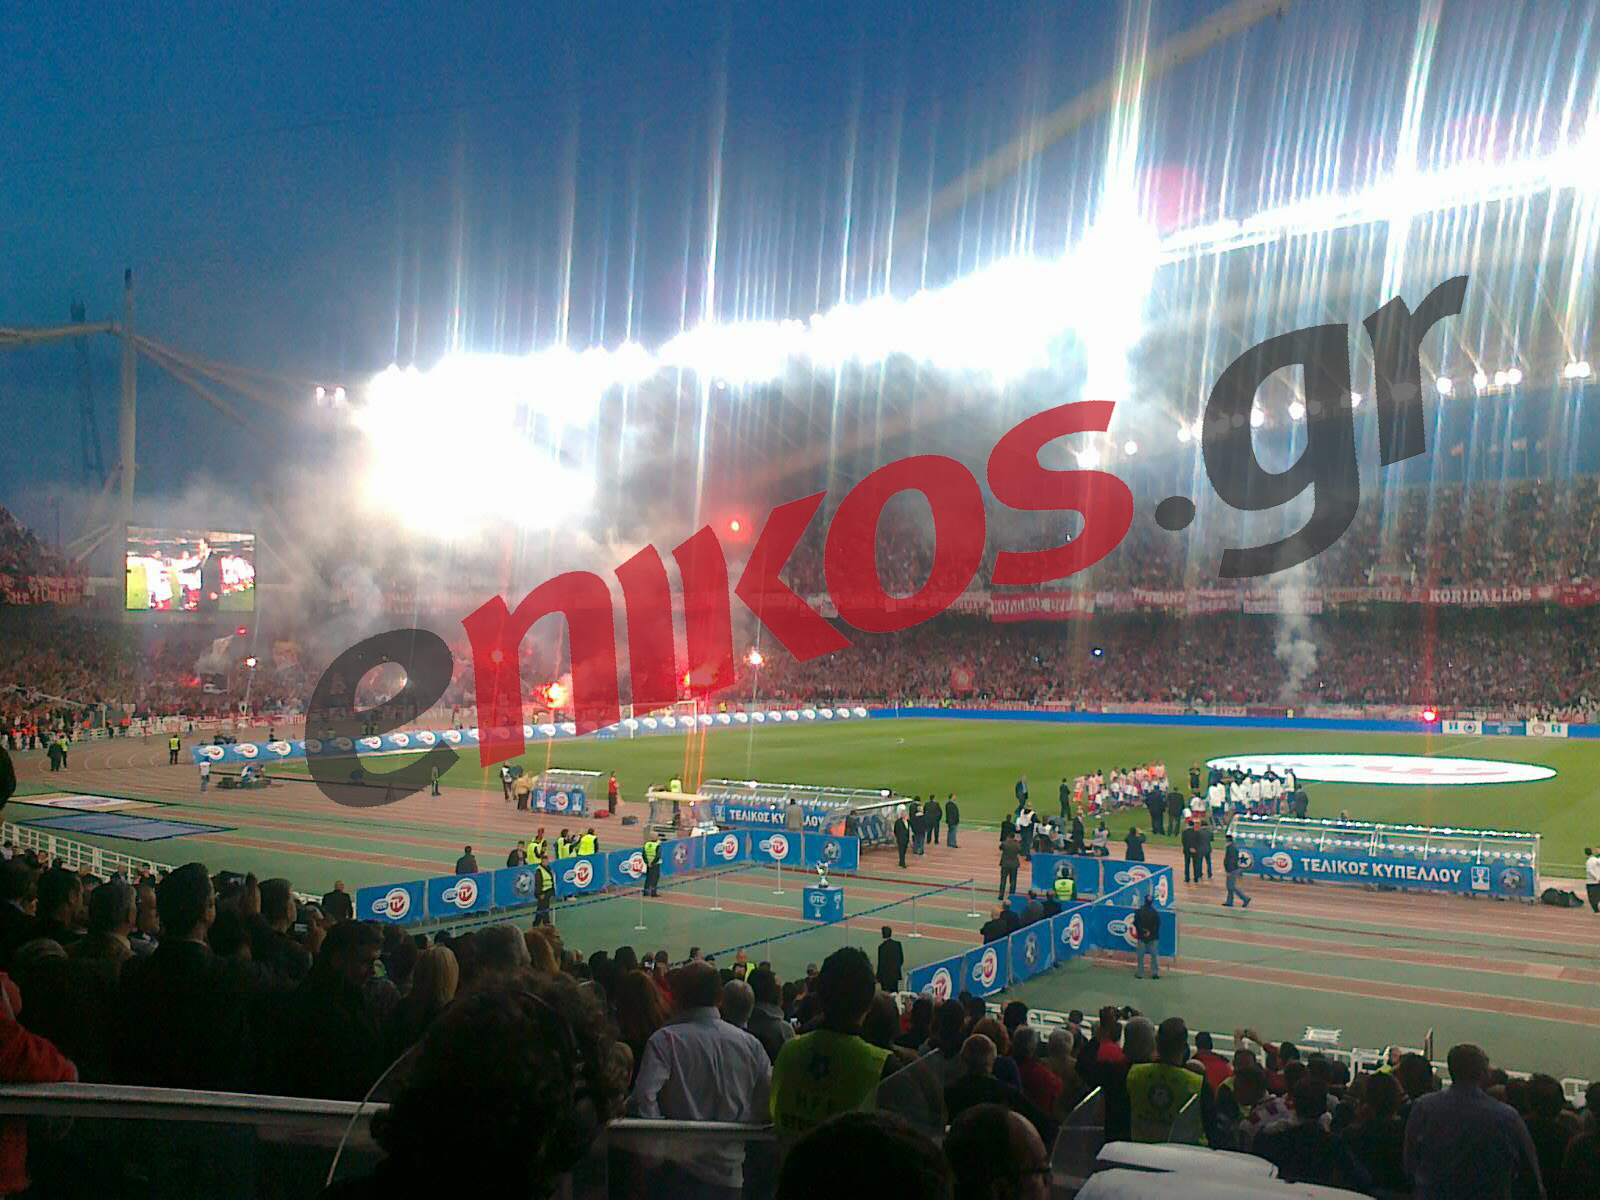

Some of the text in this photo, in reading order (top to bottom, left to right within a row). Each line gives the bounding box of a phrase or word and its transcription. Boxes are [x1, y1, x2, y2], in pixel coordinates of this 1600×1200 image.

[729, 809, 770, 823] ΤΕΛΙΚΟΣ
[1300, 857, 1462, 883] ΤΕΛΙΚΟΣ ΚΥΠΕΛΛΟΥ
